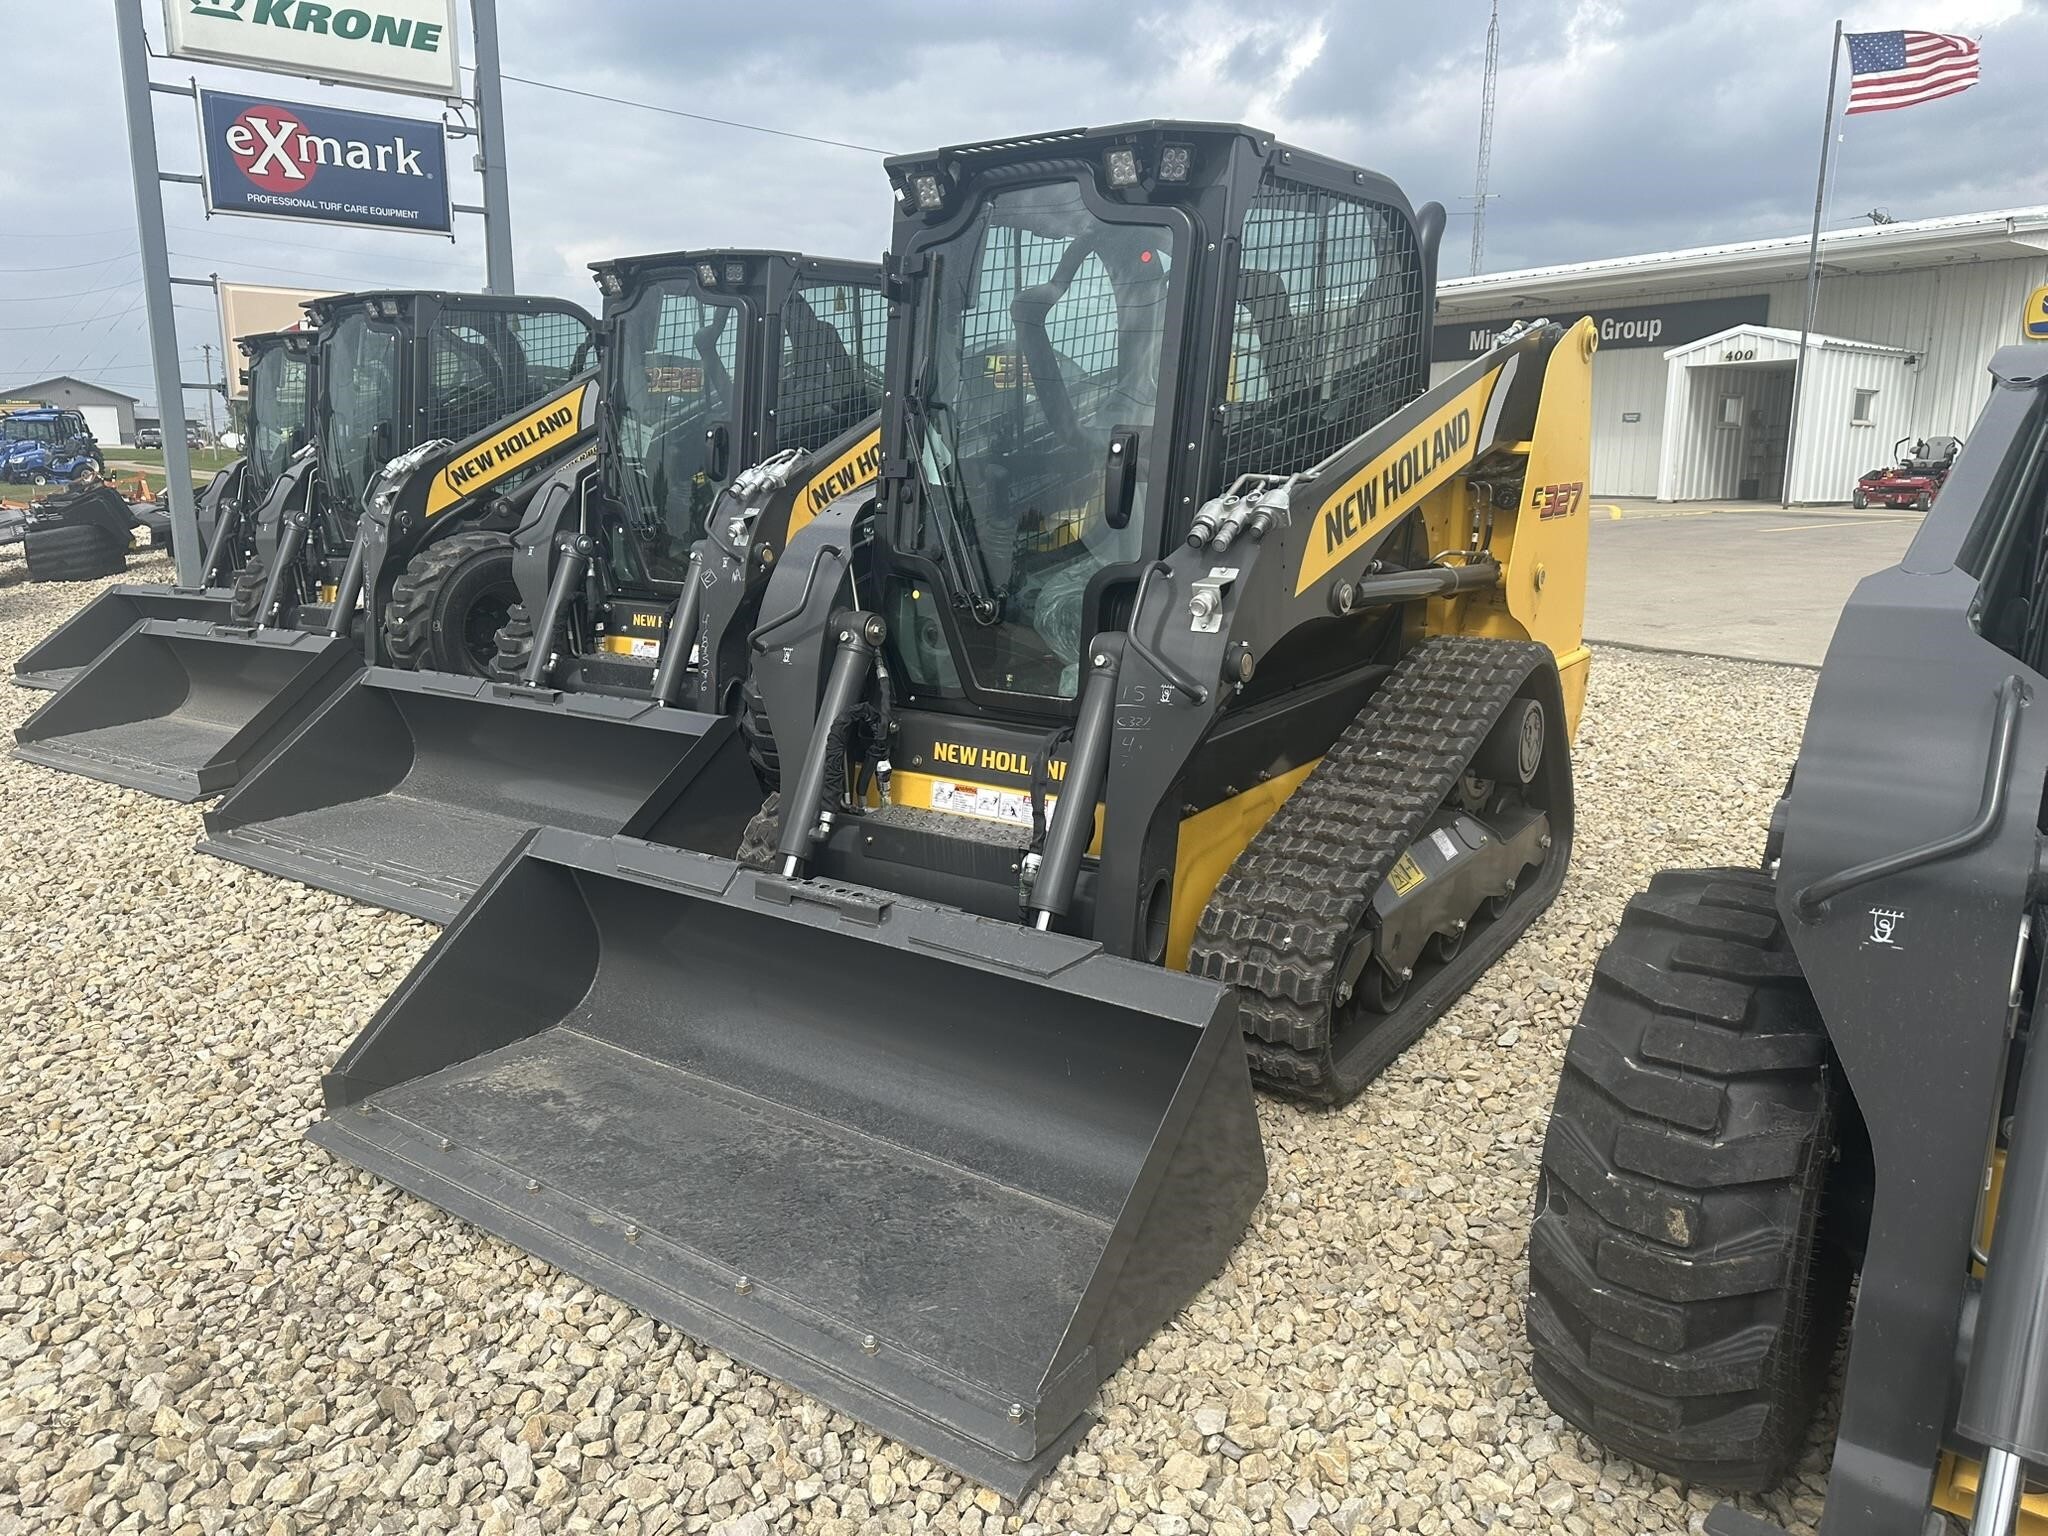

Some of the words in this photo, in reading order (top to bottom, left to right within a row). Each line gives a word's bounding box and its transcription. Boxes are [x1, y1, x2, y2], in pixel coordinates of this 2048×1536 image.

[252, 0, 443, 52] KRONE
[246, 193, 317, 210] PROFESSIONAL
[318, 201, 342, 212] TURF
[343, 203, 369, 215] CARE
[369, 206, 419, 220] EQUIPMENT
[1601, 318, 1662, 342] Group
[1725, 349, 1754, 362] 400
[449, 449, 495, 487] NEW
[493, 406, 573, 462] HOLLAND
[811, 461, 856, 511] NEW
[1325, 475, 1378, 555] NEW
[1382, 408, 1471, 509] HOLLAND
[633, 613, 657, 628] NEW
[933, 741, 978, 766] NEW
[980, 748, 1068, 781] HOLLN
